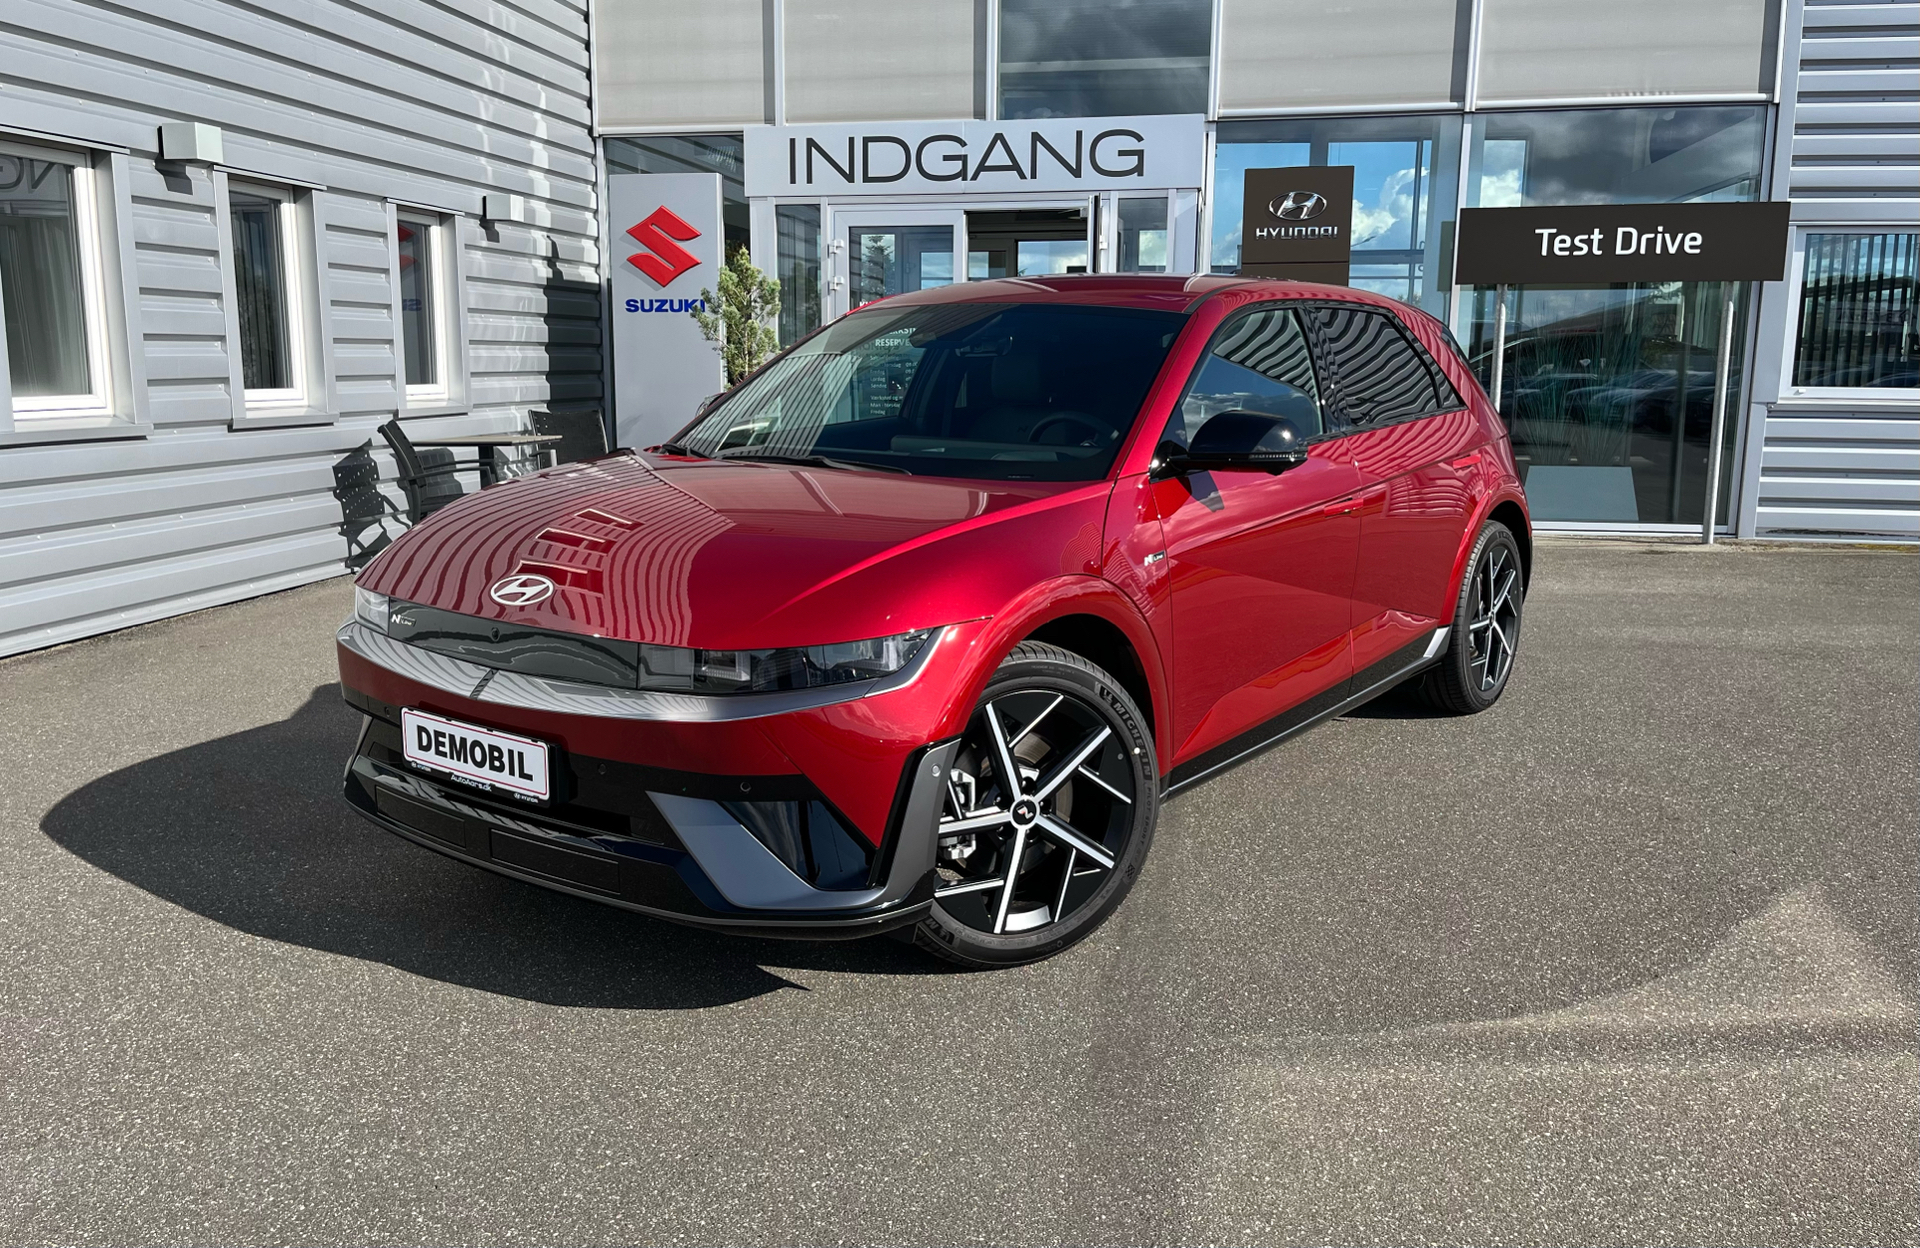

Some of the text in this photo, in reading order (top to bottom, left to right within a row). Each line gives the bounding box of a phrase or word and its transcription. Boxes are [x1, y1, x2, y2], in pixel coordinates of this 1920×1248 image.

[789, 128, 1145, 185] INDGANG
[1256, 226, 1338, 239] HYUNDAI
[1535, 226, 1703, 256] Test Drive
[625, 299, 706, 313] SUZUKI
[416, 724, 534, 782] DEMOBIL
[1112, 702, 1151, 776] MICHELIN
